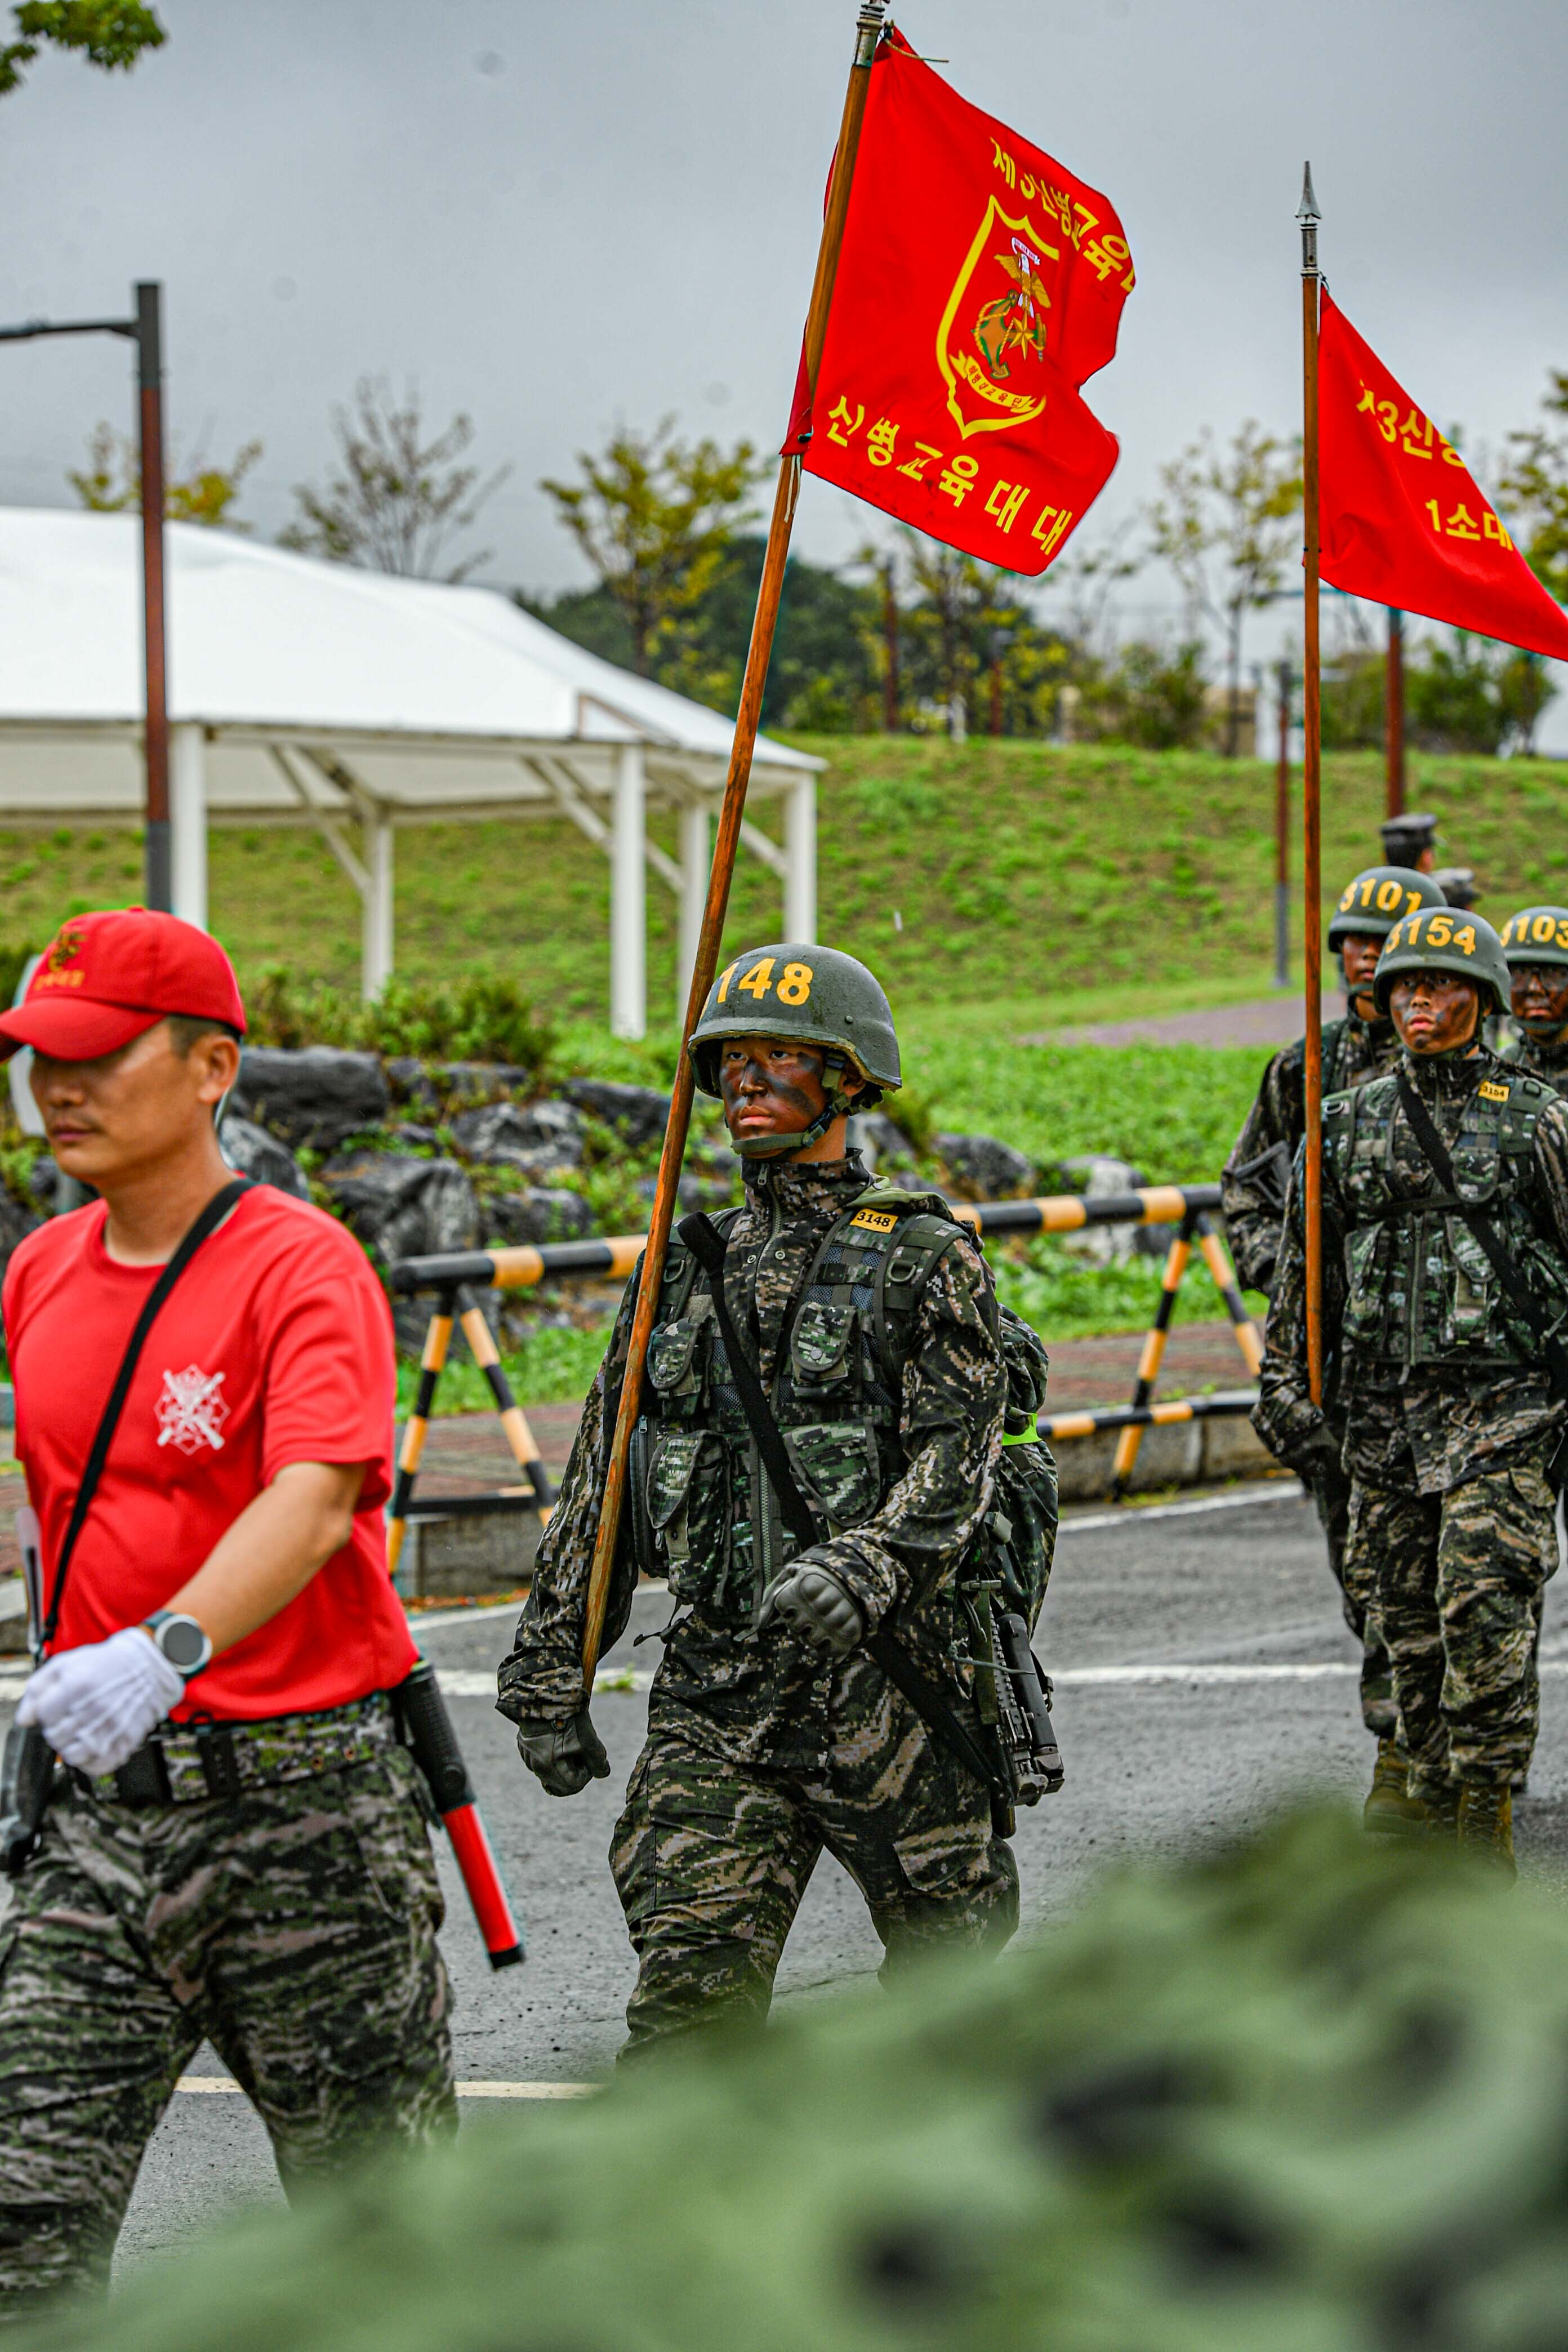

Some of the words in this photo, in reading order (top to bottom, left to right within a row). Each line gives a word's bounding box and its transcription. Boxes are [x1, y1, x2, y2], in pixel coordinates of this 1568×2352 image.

[1384, 916, 1477, 955] 3154
[700, 957, 814, 1019] 148
[856, 1211, 891, 1227] 3148
